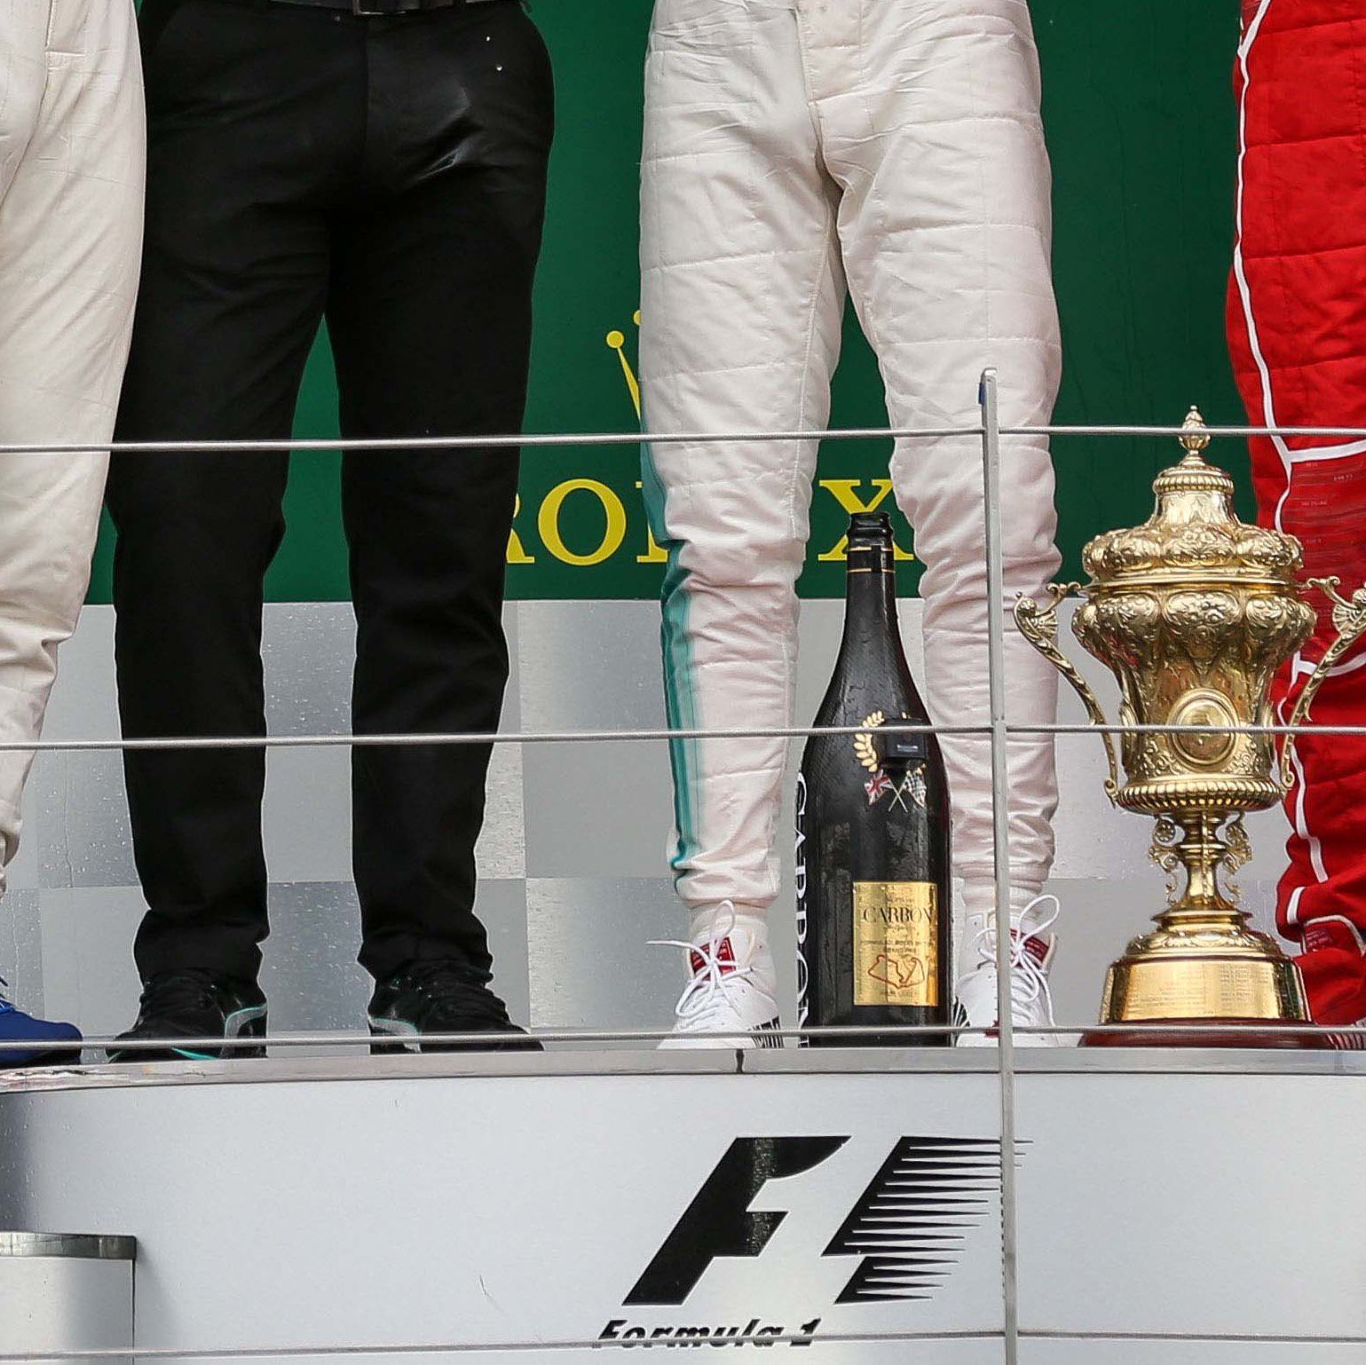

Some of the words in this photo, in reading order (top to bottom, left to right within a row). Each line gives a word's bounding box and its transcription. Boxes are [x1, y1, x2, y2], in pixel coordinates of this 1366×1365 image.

[863, 906, 933, 924] CARBON
[621, 1134, 1034, 1306] F1
[592, 1317, 783, 1349] Formula
